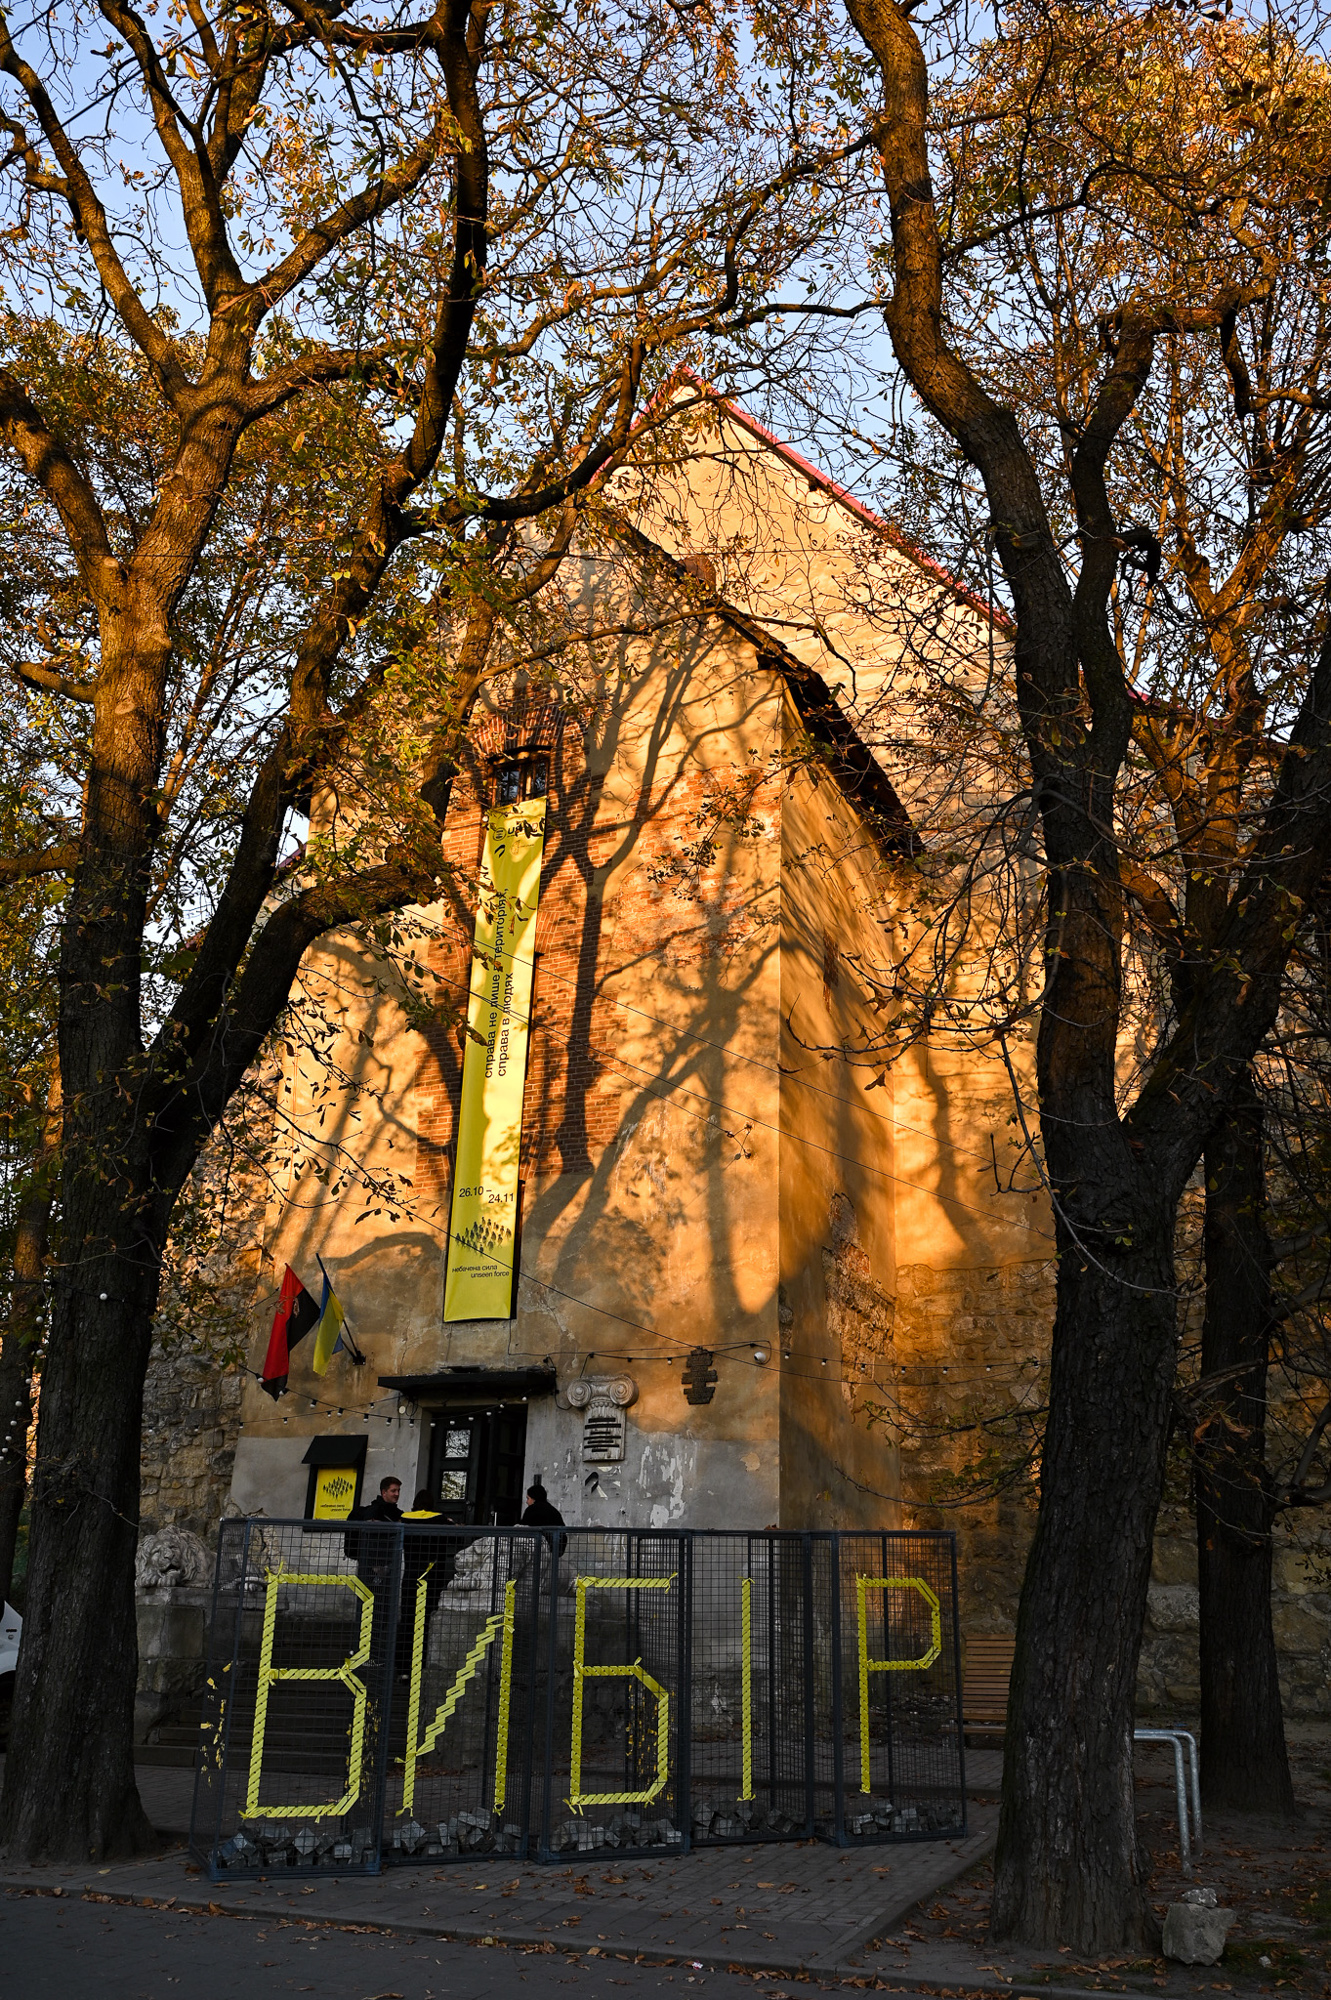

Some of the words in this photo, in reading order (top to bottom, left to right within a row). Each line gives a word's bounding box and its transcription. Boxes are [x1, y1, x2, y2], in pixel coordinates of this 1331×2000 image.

[491, 974, 500, 1008] лише
[503, 973, 514, 1014] людях
[489, 1012, 497, 1027] не
[485, 1031, 496, 1078] справа
[498, 1029, 509, 1077] справа
[459, 1186, 484, 1198] 26.10
[488, 1193, 514, 1204] 24.11
[452, 1265, 481, 1273] небачена
[494, 1270, 510, 1278] force
